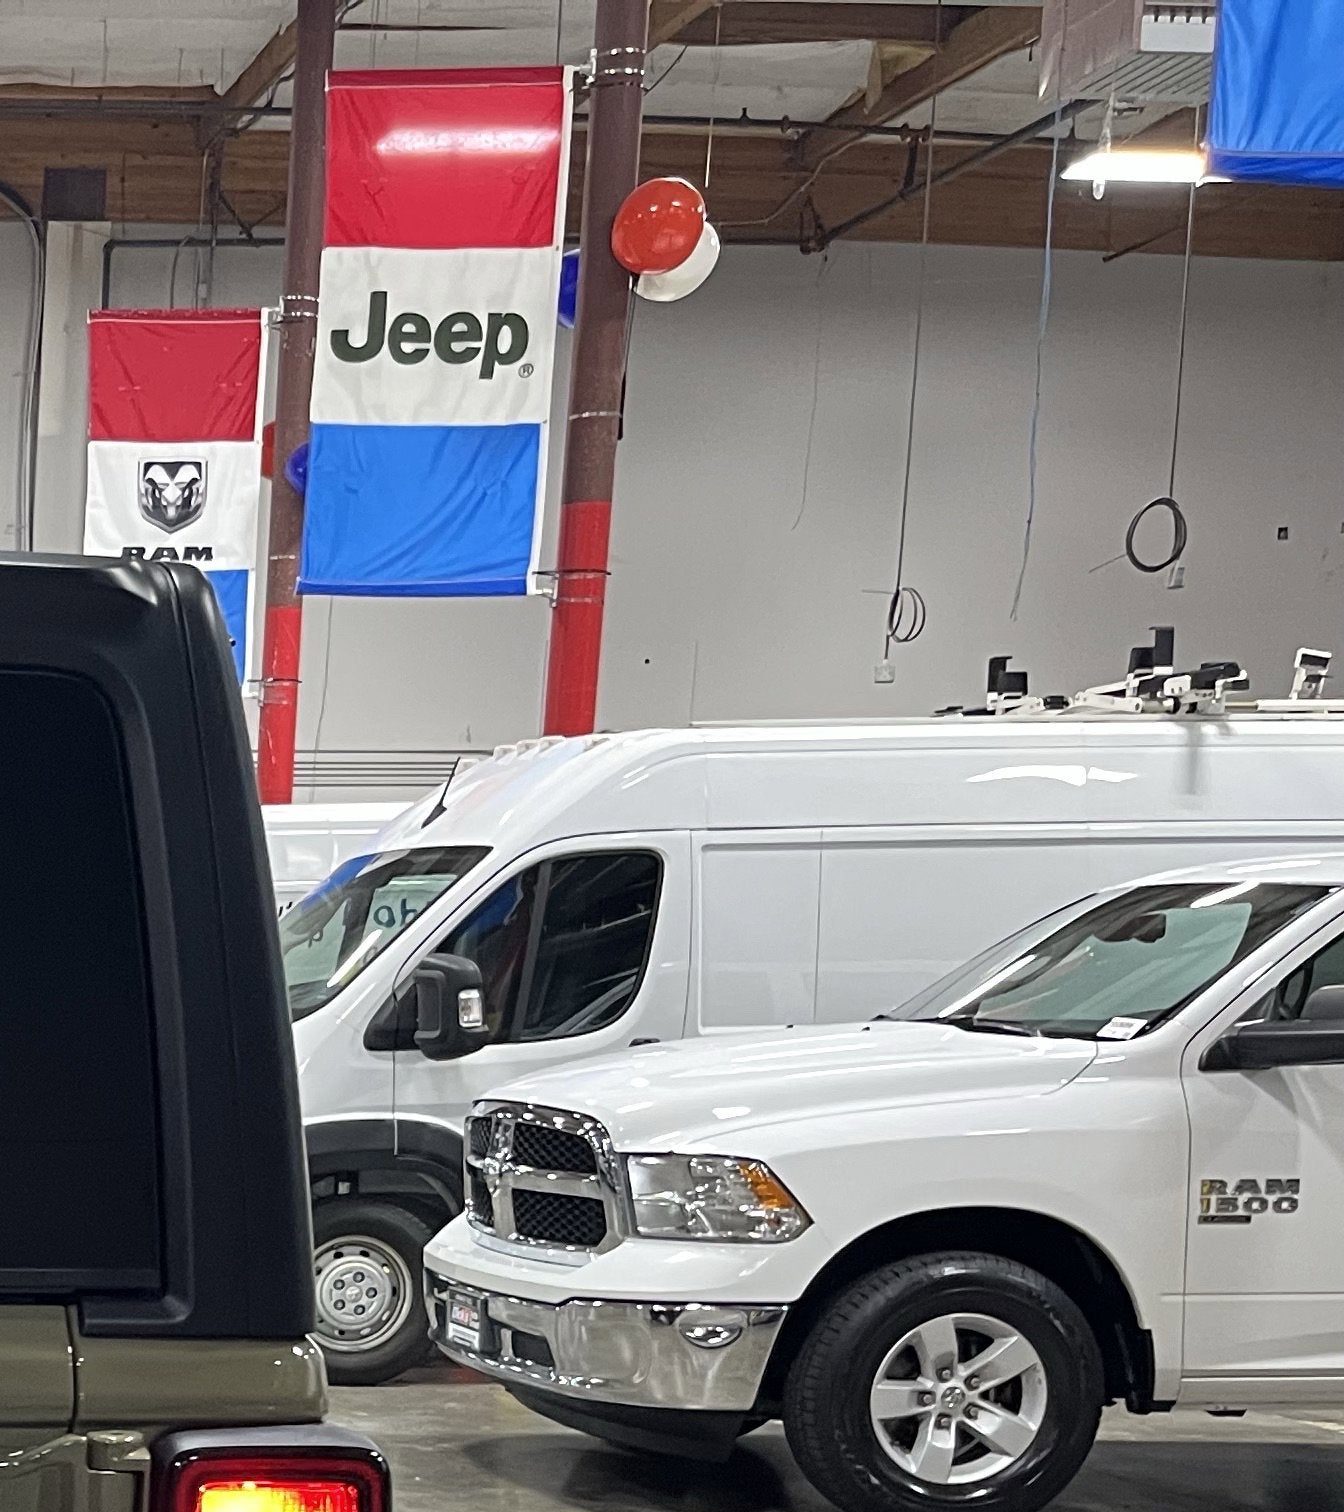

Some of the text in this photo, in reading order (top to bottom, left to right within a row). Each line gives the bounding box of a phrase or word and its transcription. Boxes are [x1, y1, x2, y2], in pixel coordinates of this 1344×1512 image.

[330, 291, 529, 379] Jeep
[120, 546, 213, 561] RAM
[1201, 1178, 1300, 1195] RAM
[1200, 1196, 1299, 1214] 1500
